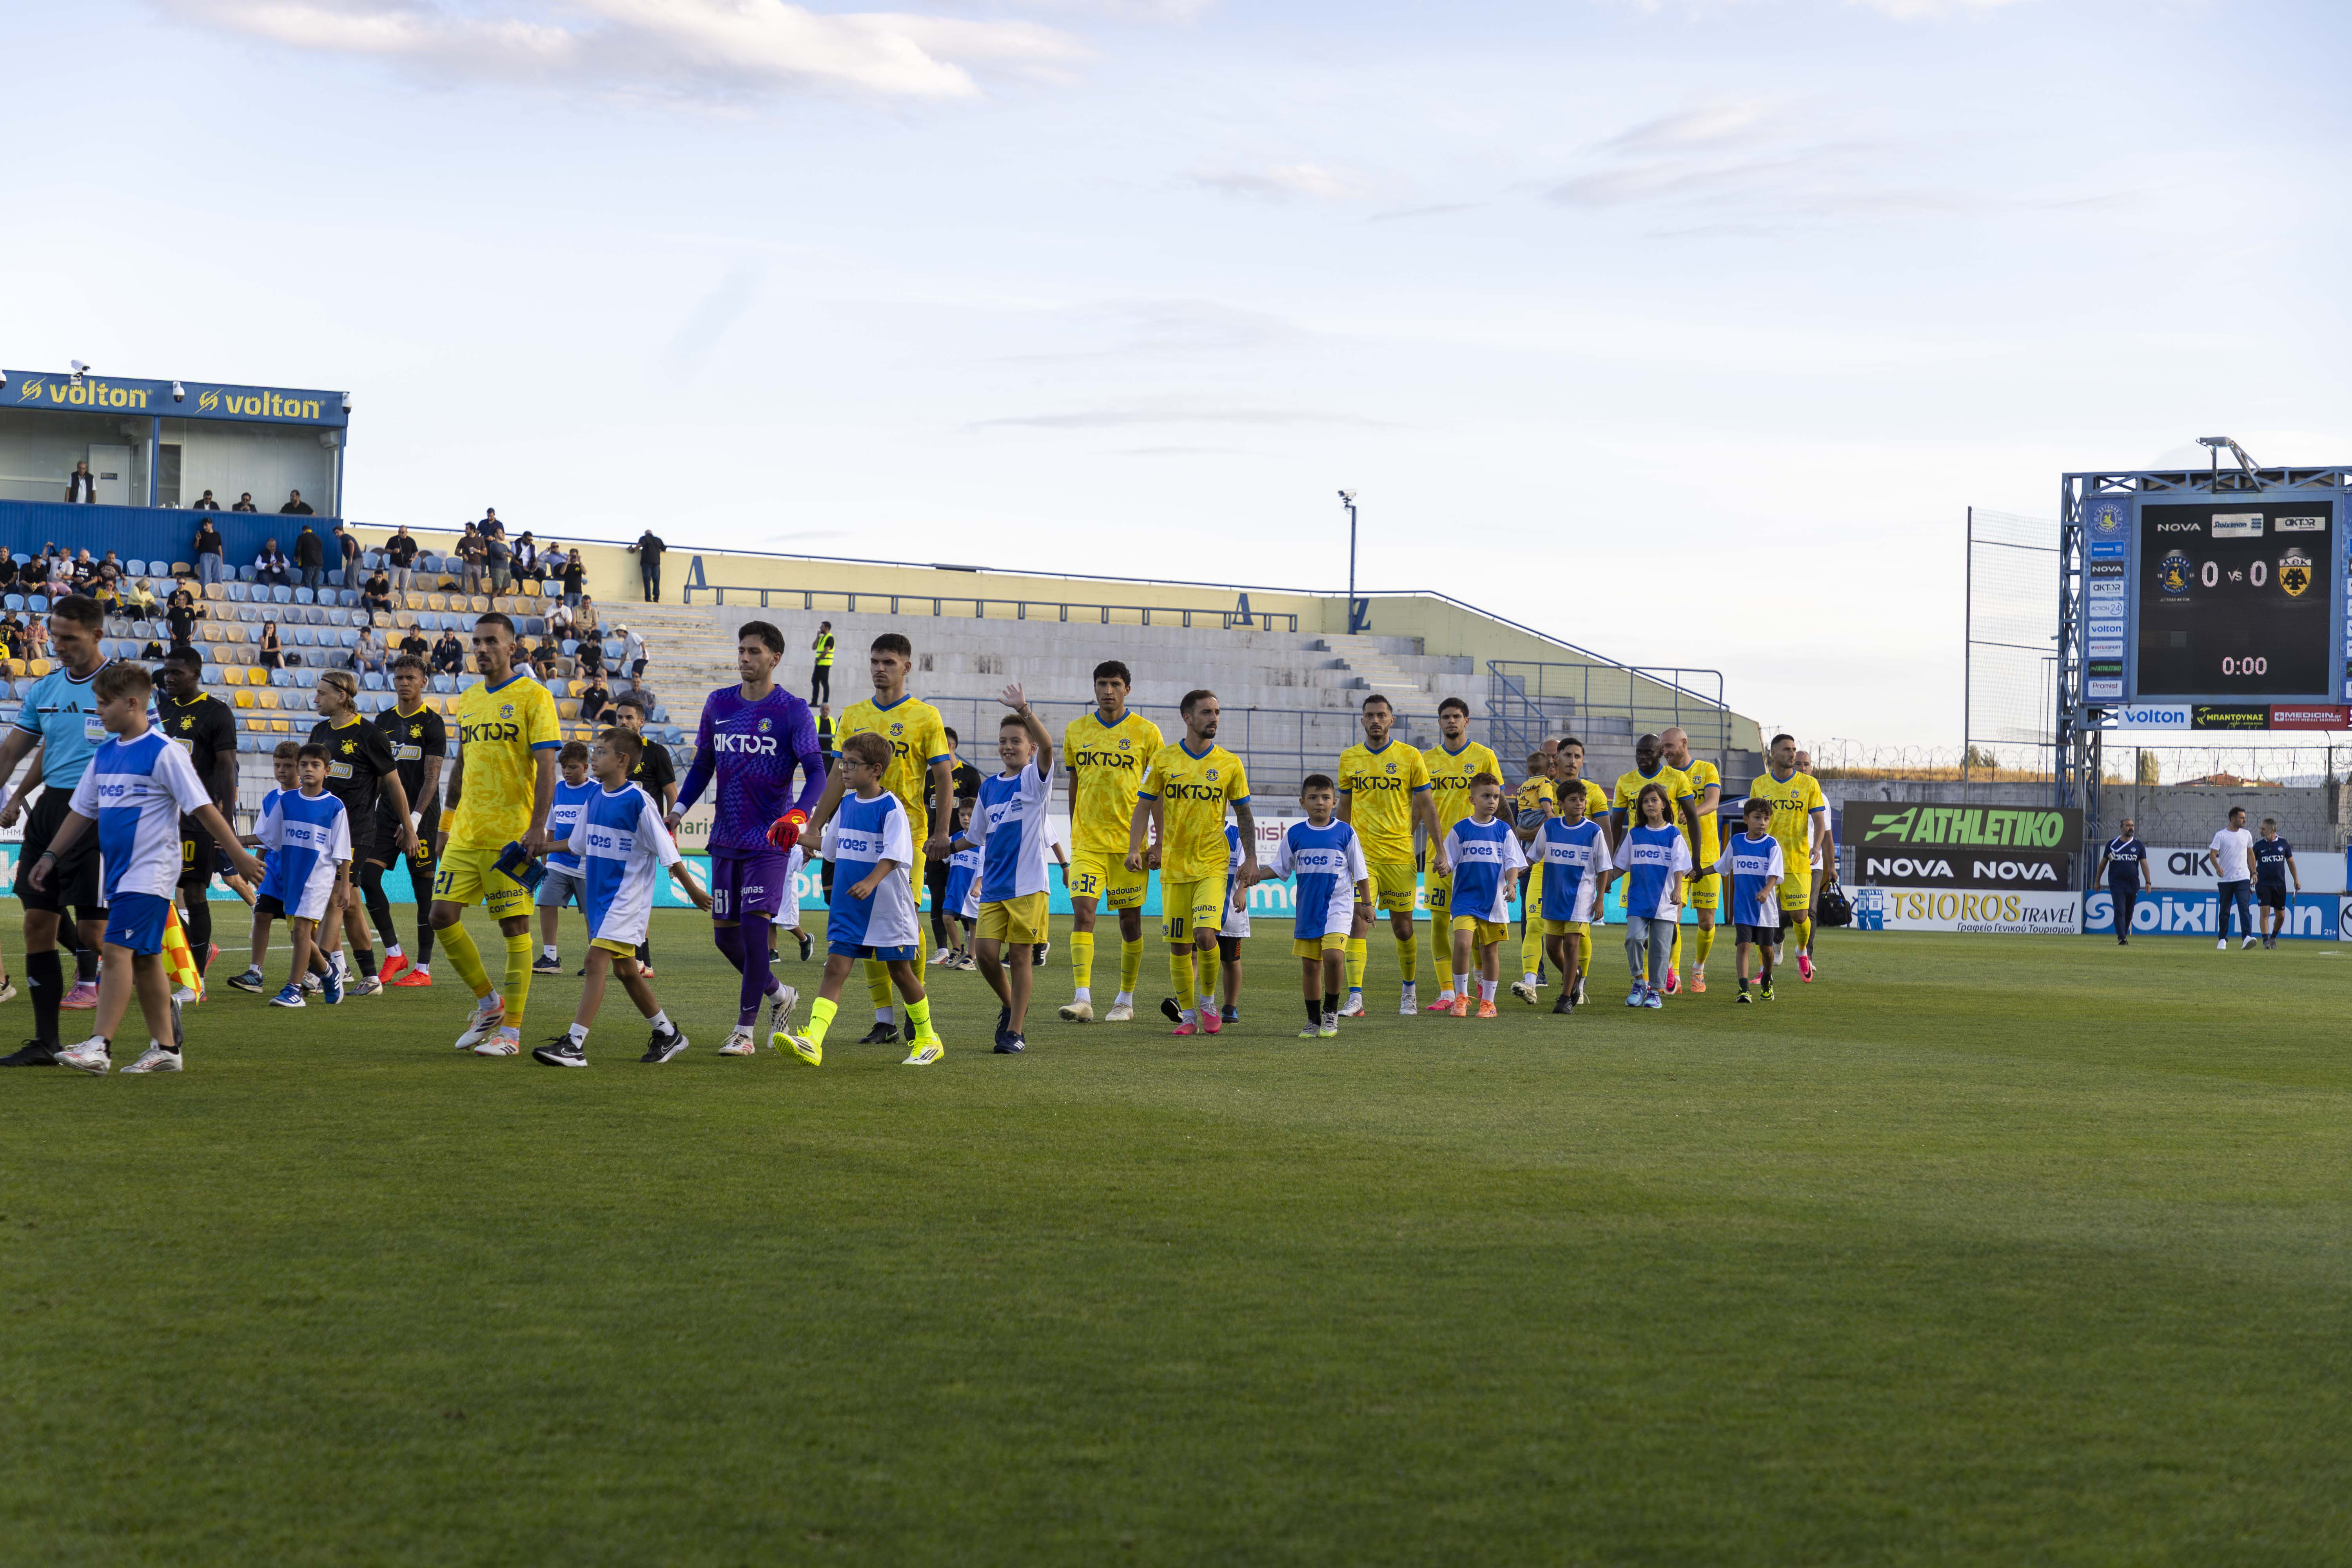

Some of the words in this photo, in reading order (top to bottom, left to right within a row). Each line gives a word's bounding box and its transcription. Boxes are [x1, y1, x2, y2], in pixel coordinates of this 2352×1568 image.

[49, 379, 146, 408] volton
[225, 390, 319, 419] volton
[2157, 523, 2201, 532] NOVA
[2202, 561, 2219, 587] 0
[2250, 560, 2267, 587] 0
[2222, 657, 2267, 675] 0:00
[2125, 709, 2185, 724] volton
[1911, 807, 2064, 848] ATHLETIKO
[1462, 846, 1493, 856] iroes
[1634, 849, 1660, 858] iroes
[1867, 858, 1954, 878] NOVA
[1973, 861, 2058, 881] NOVA
[435, 871, 454, 895] 21
[1080, 874, 1097, 894] 32
[1107, 884, 1142, 896] badounas
[714, 889, 729, 914] 61
[1107, 897, 1126, 906] .com
[1379, 889, 1412, 898] badounas
[1431, 887, 1446, 907] 28
[1891, 892, 2022, 922] TSIOROS
[1171, 917, 1184, 938] 10
[1957, 922, 1993, 933] Γραφείο
[1994, 923, 2026, 933] Γενικού
[2029, 924, 2075, 934] Τουρισμού
